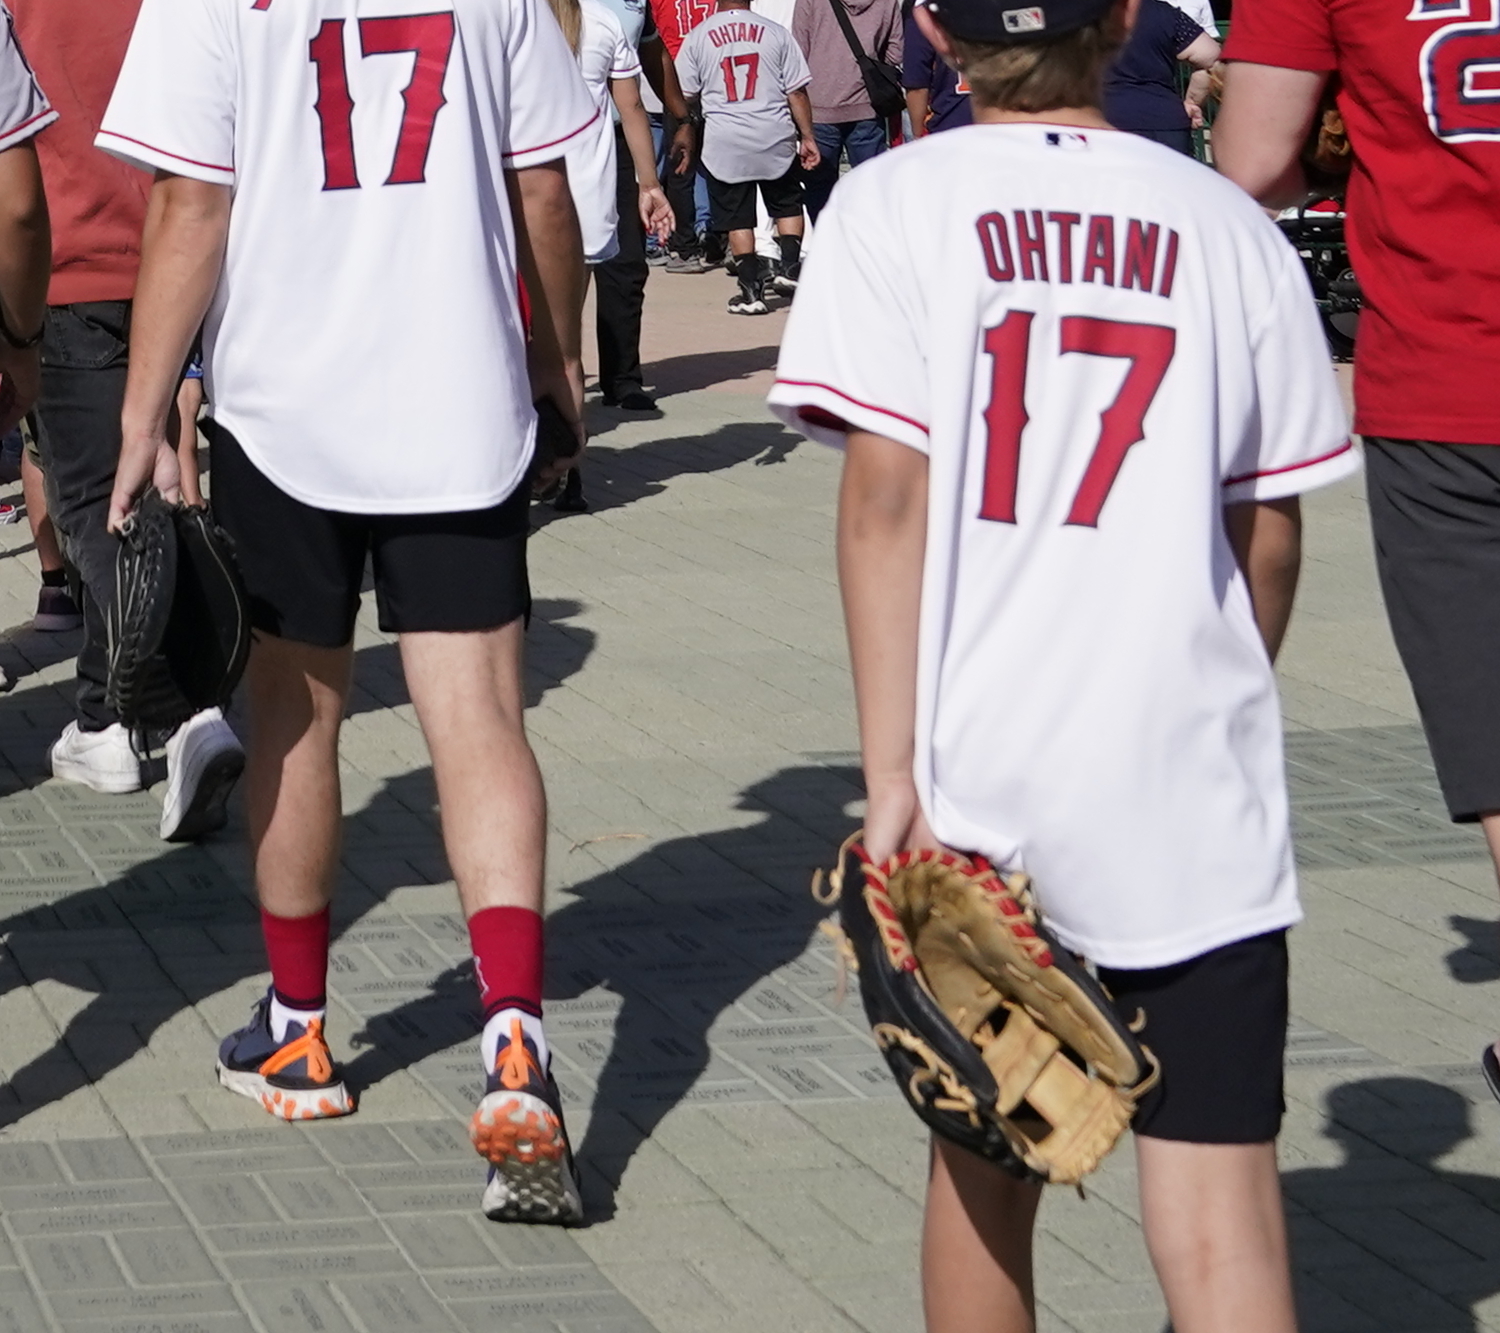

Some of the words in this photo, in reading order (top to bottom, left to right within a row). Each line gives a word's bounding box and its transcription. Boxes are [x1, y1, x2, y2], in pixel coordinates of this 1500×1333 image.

[707, 22, 766, 48] OHTANI
[720, 52, 761, 103] 17
[308, 9, 455, 193] 17
[976, 209, 1180, 300] OHTANI
[977, 310, 1178, 528] 17
